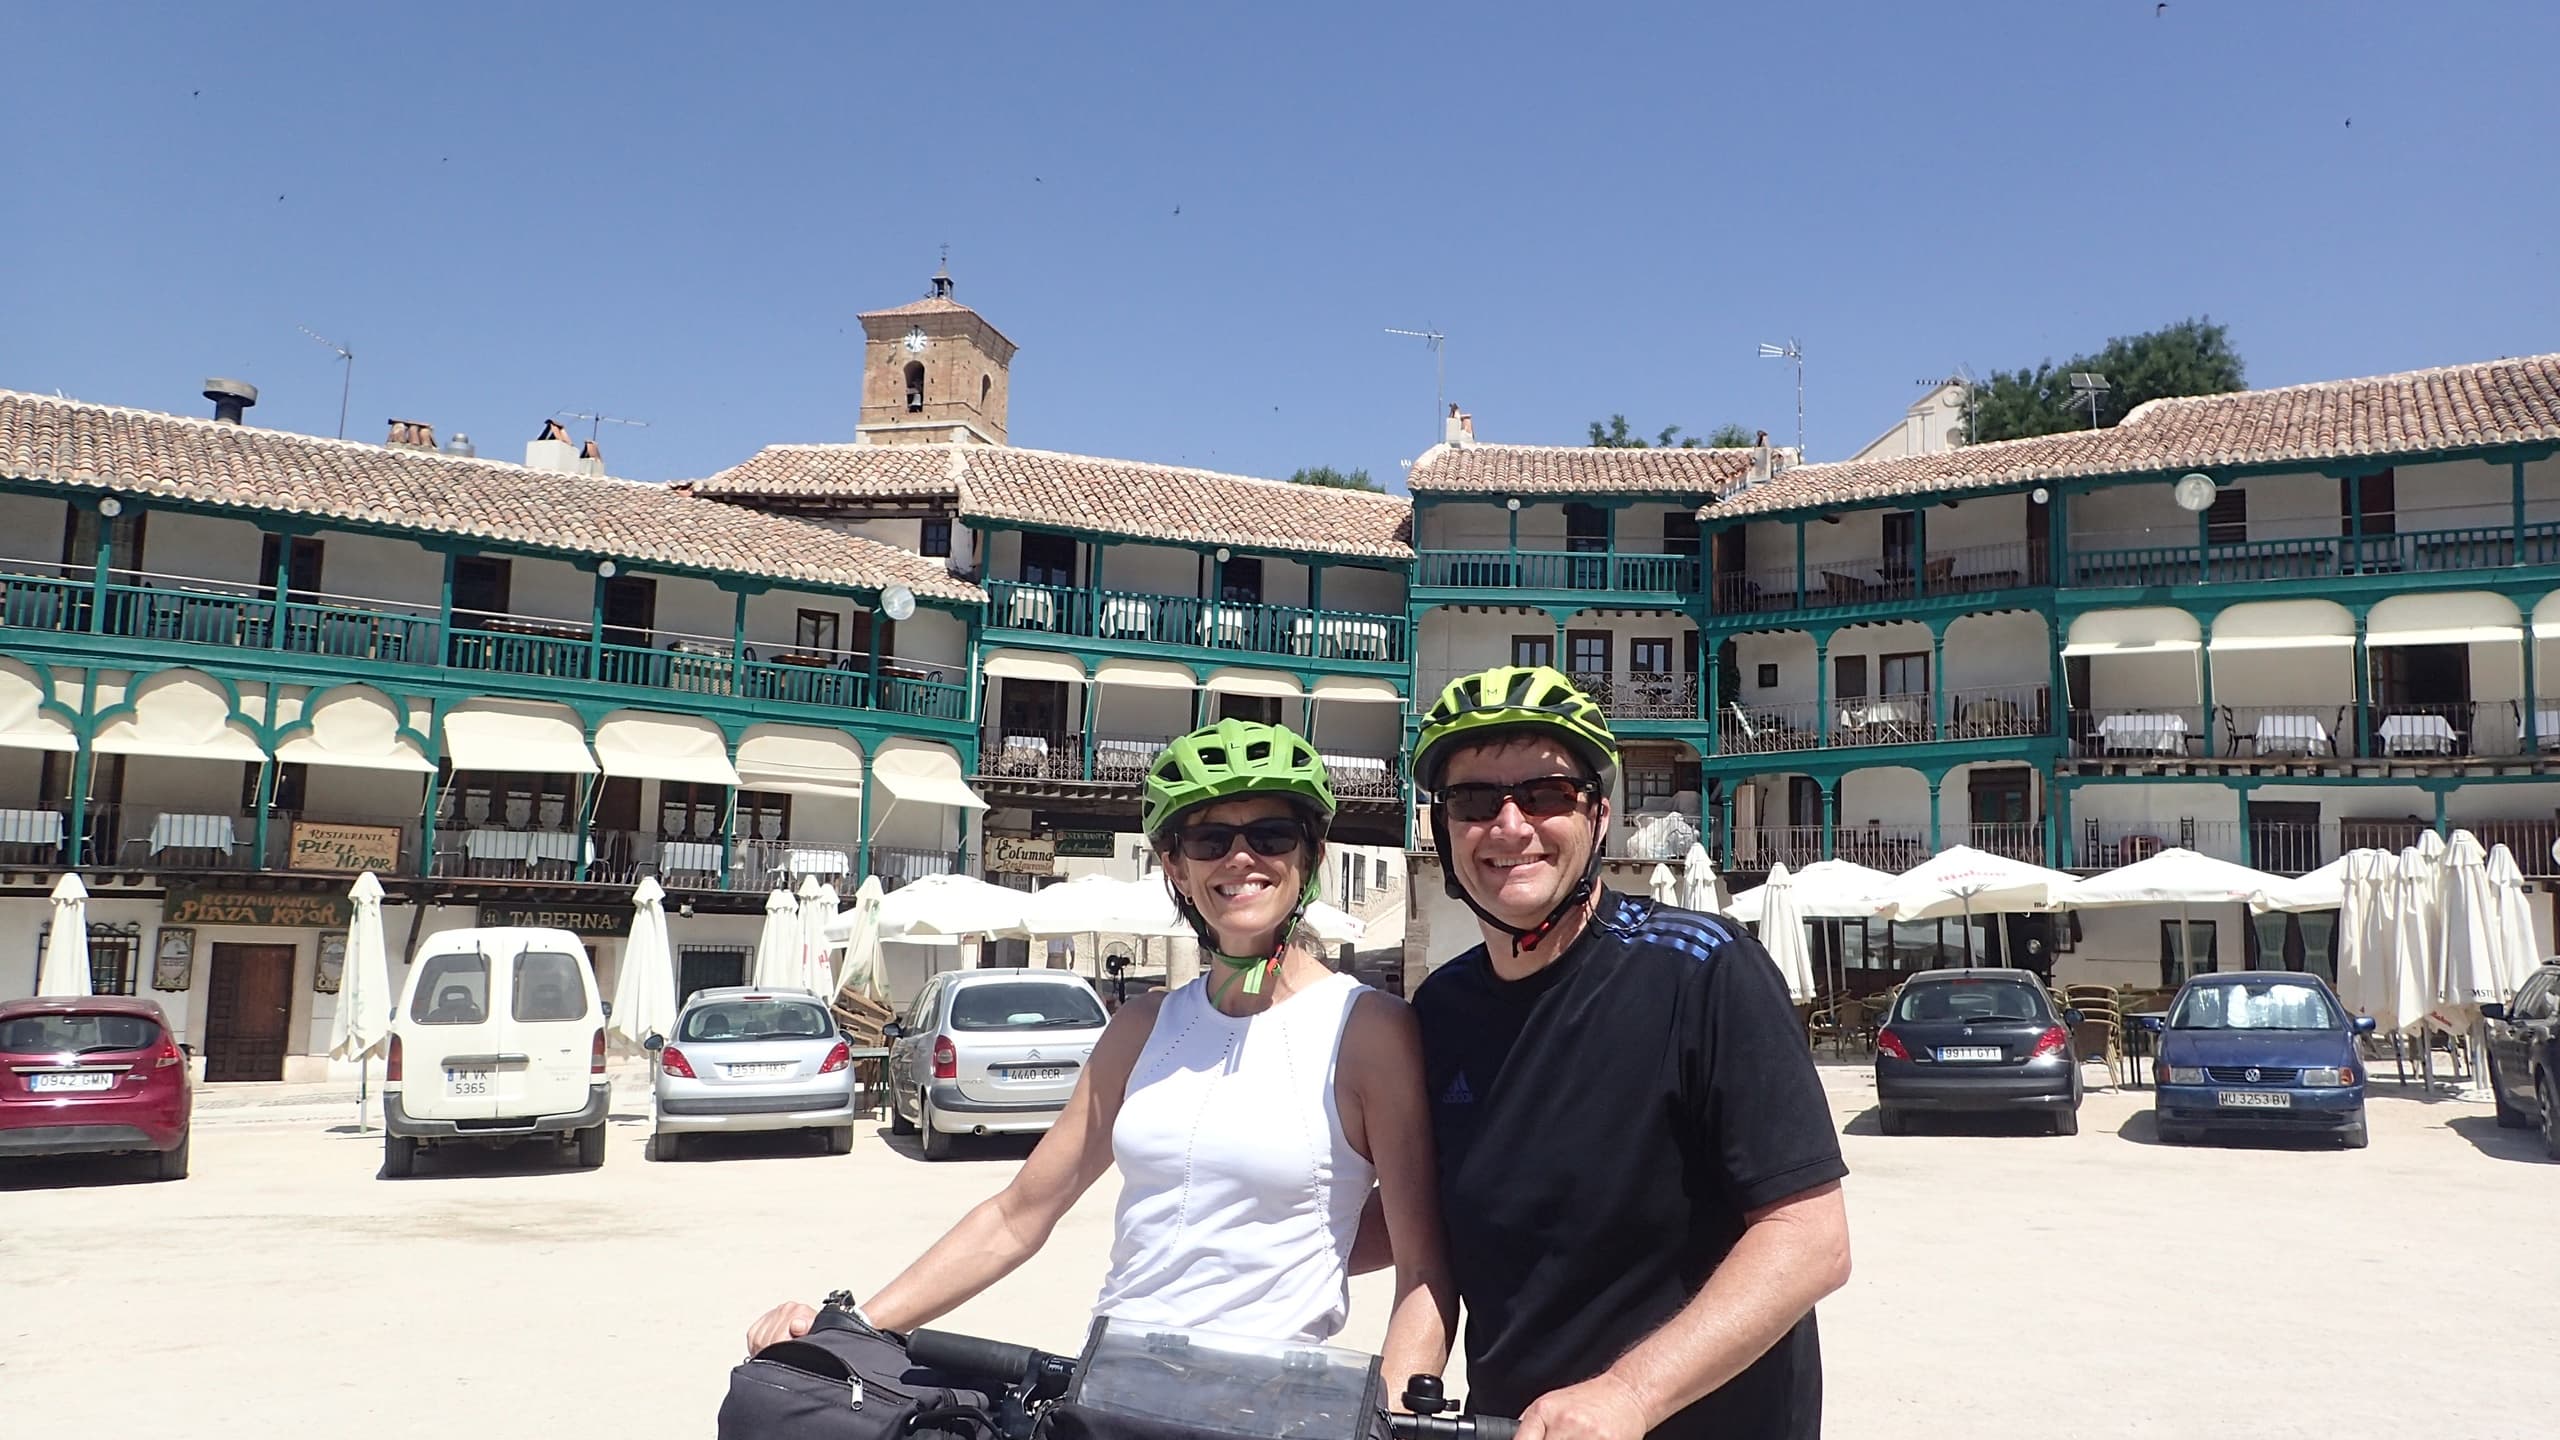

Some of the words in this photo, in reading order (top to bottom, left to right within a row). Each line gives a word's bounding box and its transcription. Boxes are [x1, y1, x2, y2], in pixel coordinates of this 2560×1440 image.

[310, 829, 384, 841] RESTAURANTE
[297, 839, 358, 856] PLAZA
[997, 846, 1054, 861] Columna
[335, 852, 392, 873] MAYOR
[201, 893, 321, 909] RESTAURANTE
[173, 900, 258, 922] PLAZA
[509, 911, 614, 930] TABERNA
[1945, 1048, 1973, 1058] 9911
[1977, 1047, 1999, 1058] GYT
[460, 1070, 468, 1080] M
[473, 1069, 488, 1080] VK
[734, 1064, 762, 1074] 3591
[766, 1063, 787, 1073] HKR
[1011, 1069, 1037, 1080] 4440
[1041, 1068, 1061, 1079] CCR
[40, 1075, 77, 1087] 0942
[82, 1074, 110, 1086] GMN
[455, 1082, 486, 1094] 5365
[2239, 1093, 2271, 1105] 3253
[2272, 1094, 2289, 1105] BV
